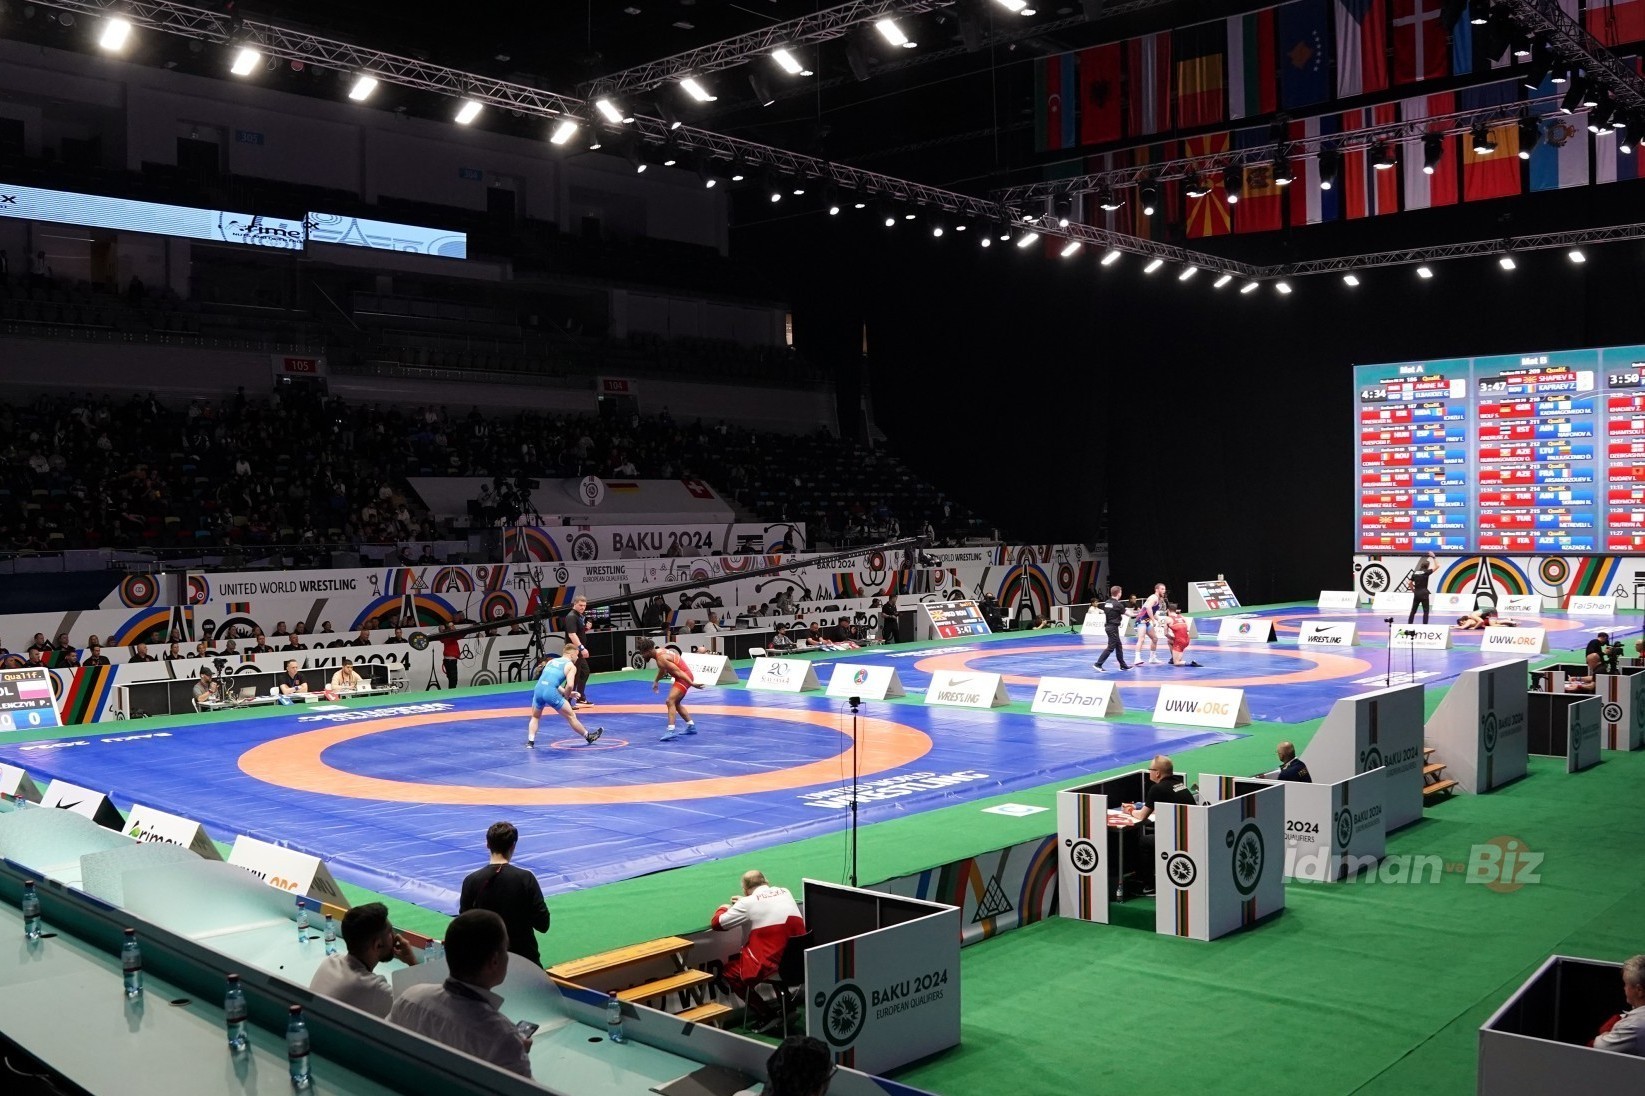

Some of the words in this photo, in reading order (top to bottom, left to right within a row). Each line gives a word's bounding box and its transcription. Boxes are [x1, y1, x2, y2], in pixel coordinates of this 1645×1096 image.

[292, 361, 309, 371] 105
[1610, 374, 1640, 384] 3:50
[608, 382, 623, 390] 104
[1480, 382, 1506, 392] 3:47
[1362, 389, 1387, 399] 4:34
[613, 532, 663, 552] BAKU
[669, 531, 713, 549] 2024
[955, 553, 982, 561] WRESTLING
[817, 560, 836, 569] BAKU
[838, 560, 856, 569] 2024
[586, 566, 626, 576] WRESTLING
[220, 582, 258, 596] UNITED
[260, 581, 297, 594] WORLD
[299, 579, 356, 592] WRESTLING
[1573, 602, 1612, 610] TaiShan
[956, 626, 972, 634] 3:47
[977, 625, 984, 633] 0
[1307, 636, 1342, 644] WRESTLING
[1394, 629, 1442, 641] Armex
[1490, 636, 1537, 645] UWW.ORG
[4, 672, 42, 680] Qualif.
[0, 688, 14, 696] OL
[938, 691, 980, 704] WRESTLING
[1041, 690, 1103, 706] TaiShan
[1166, 700, 1230, 715] UWW.ORG
[28, 712, 41, 725] 0
[1384, 753, 1401, 767] BAKU
[1403, 746, 1419, 761] 2024
[1354, 810, 1370, 825] BAKU
[1369, 805, 1382, 821] 2024
[1286, 820, 1320, 834] 2024
[872, 980, 910, 1007] BAKU
[914, 968, 948, 994] 2024
[876, 1002, 910, 1020] EUROPEAN
[911, 989, 944, 1008] QUALIFIERS
